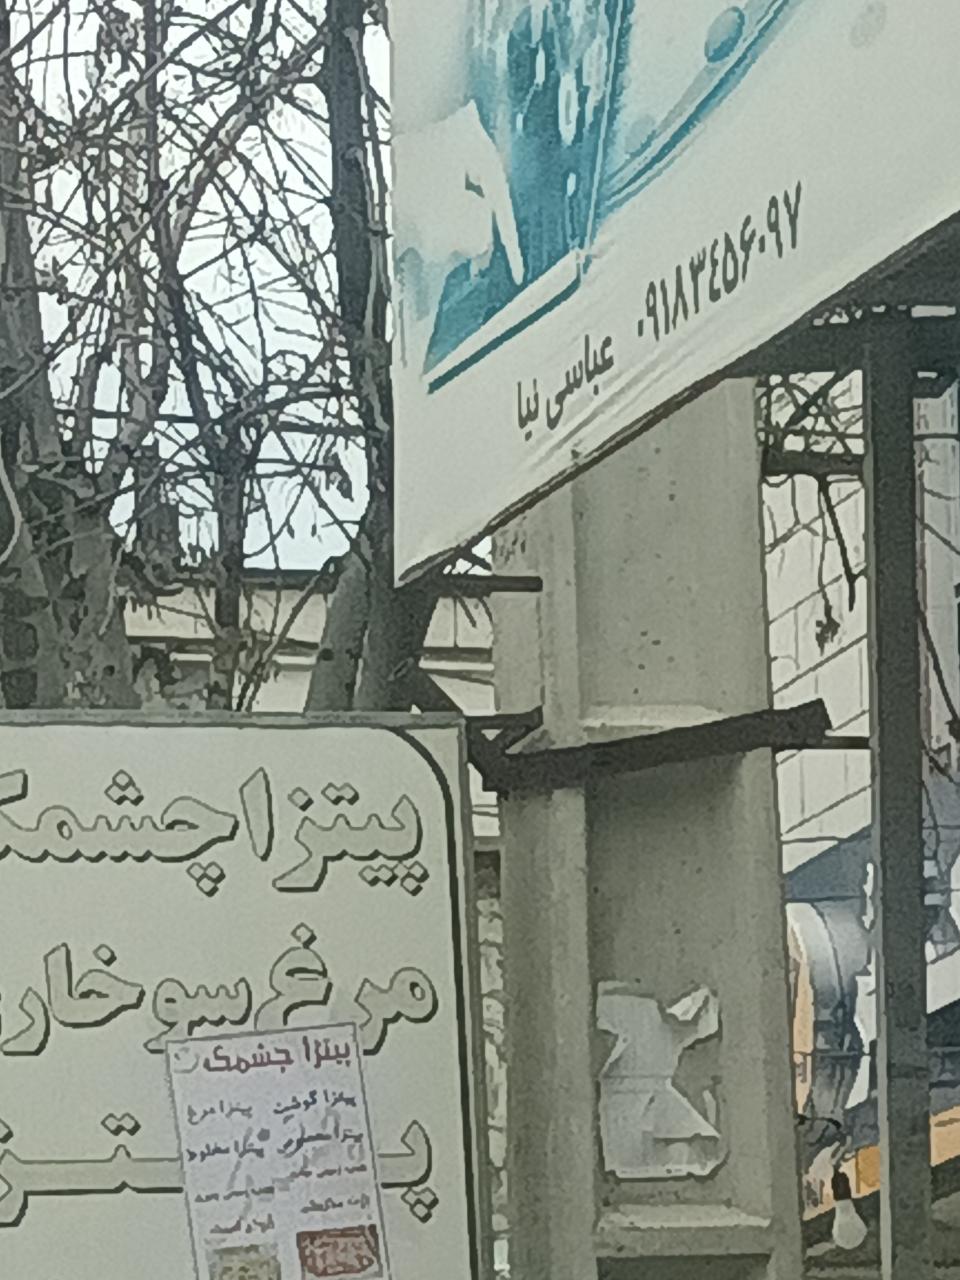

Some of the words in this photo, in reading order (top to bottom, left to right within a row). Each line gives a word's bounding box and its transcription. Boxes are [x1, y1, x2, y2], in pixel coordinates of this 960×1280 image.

[515, 377, 541, 441] نیا
[546, 333, 616, 432] عباسی
[239, 766, 430, 896] پیتزا
[0, 942, 252, 1056] سوخار
